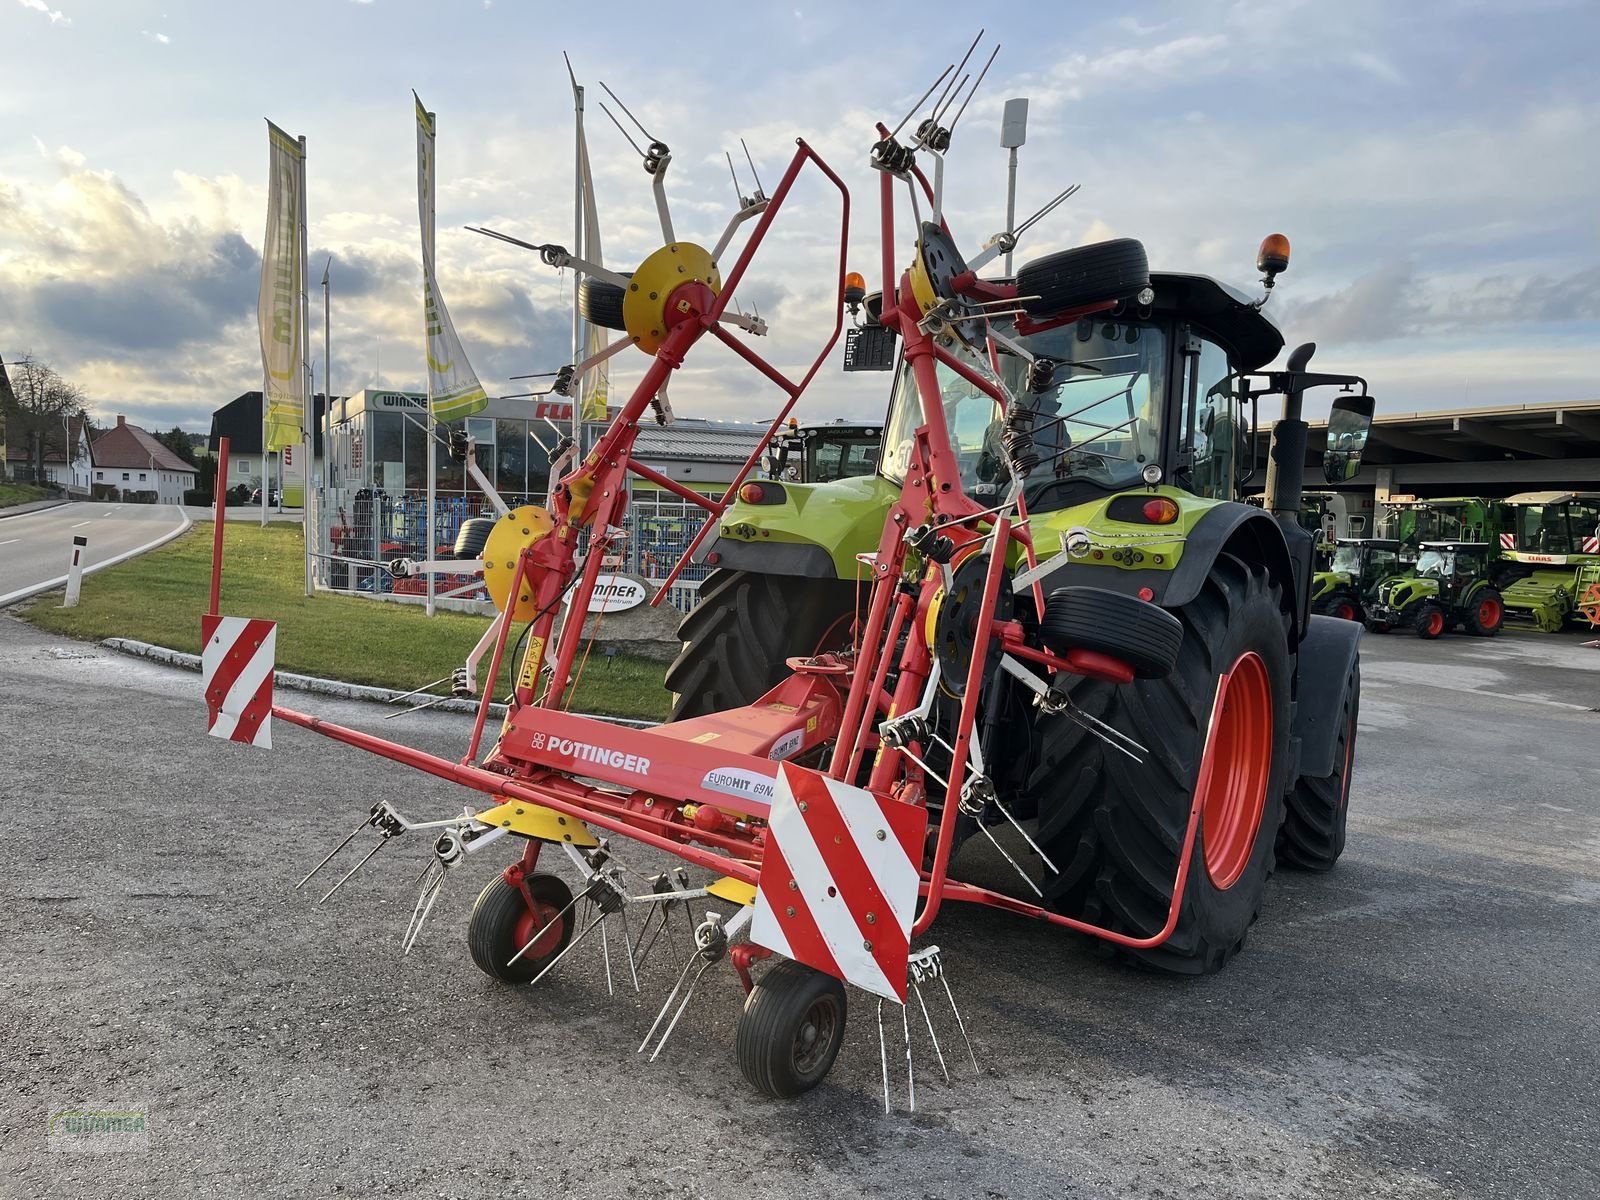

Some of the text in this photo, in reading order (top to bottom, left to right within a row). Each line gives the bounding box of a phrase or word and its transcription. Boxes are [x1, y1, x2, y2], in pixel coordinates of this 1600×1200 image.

[383, 394, 427, 408] WIMME
[571, 583, 637, 597] MMER
[546, 735, 651, 775] PÖTTINGER
[708, 772, 751, 790] EUROHIT
